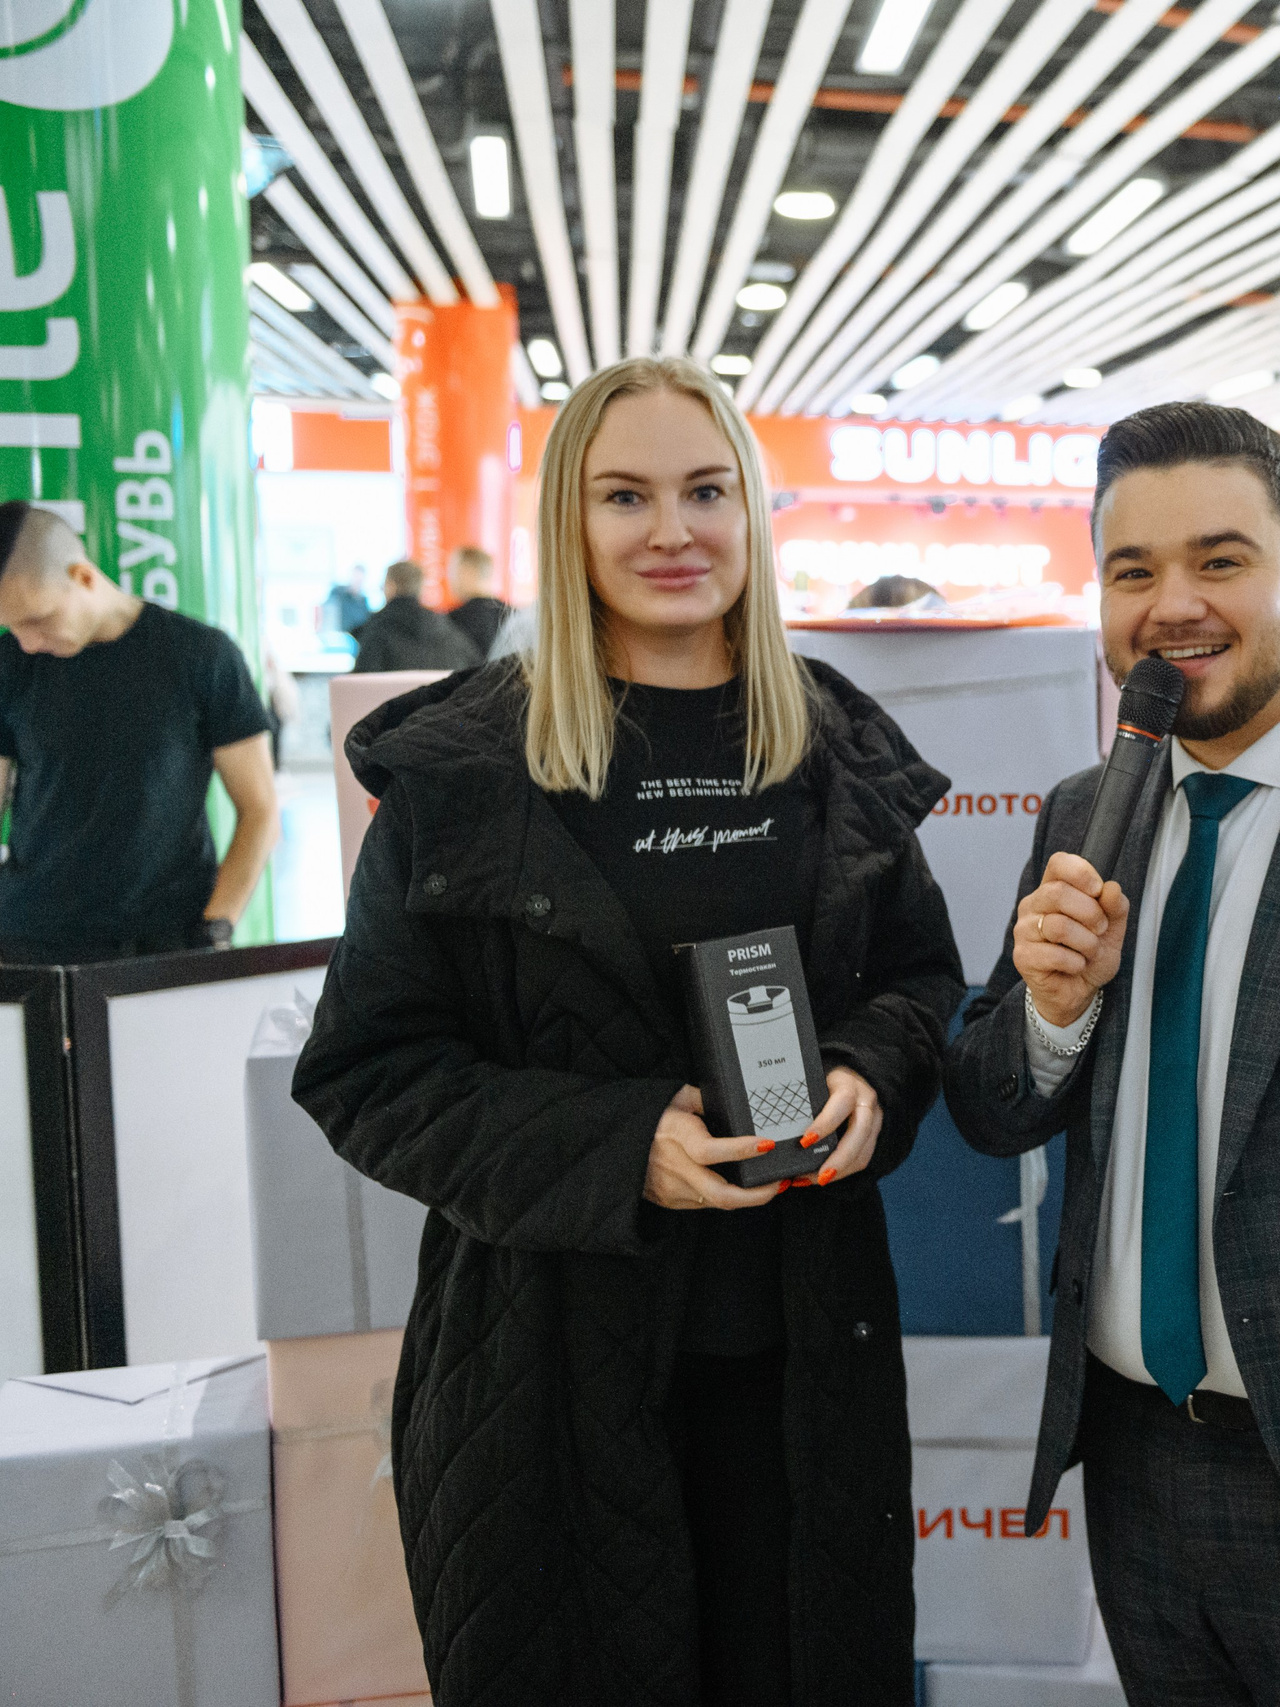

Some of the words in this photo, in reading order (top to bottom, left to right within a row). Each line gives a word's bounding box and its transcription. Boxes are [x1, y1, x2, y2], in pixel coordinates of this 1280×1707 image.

[641, 779, 663, 789] THE
[666, 778, 692, 787] BEST
[696, 778, 720, 787] TIME
[637, 790, 664, 800] NEW
[669, 787, 737, 797] BEGINNINGS
[635, 829, 656, 853] at
[712, 818, 775, 853] moment
[727, 943, 772, 963] PRISM
[729, 962, 777, 977] Термостакан
[757, 1059, 774, 1069] 350
